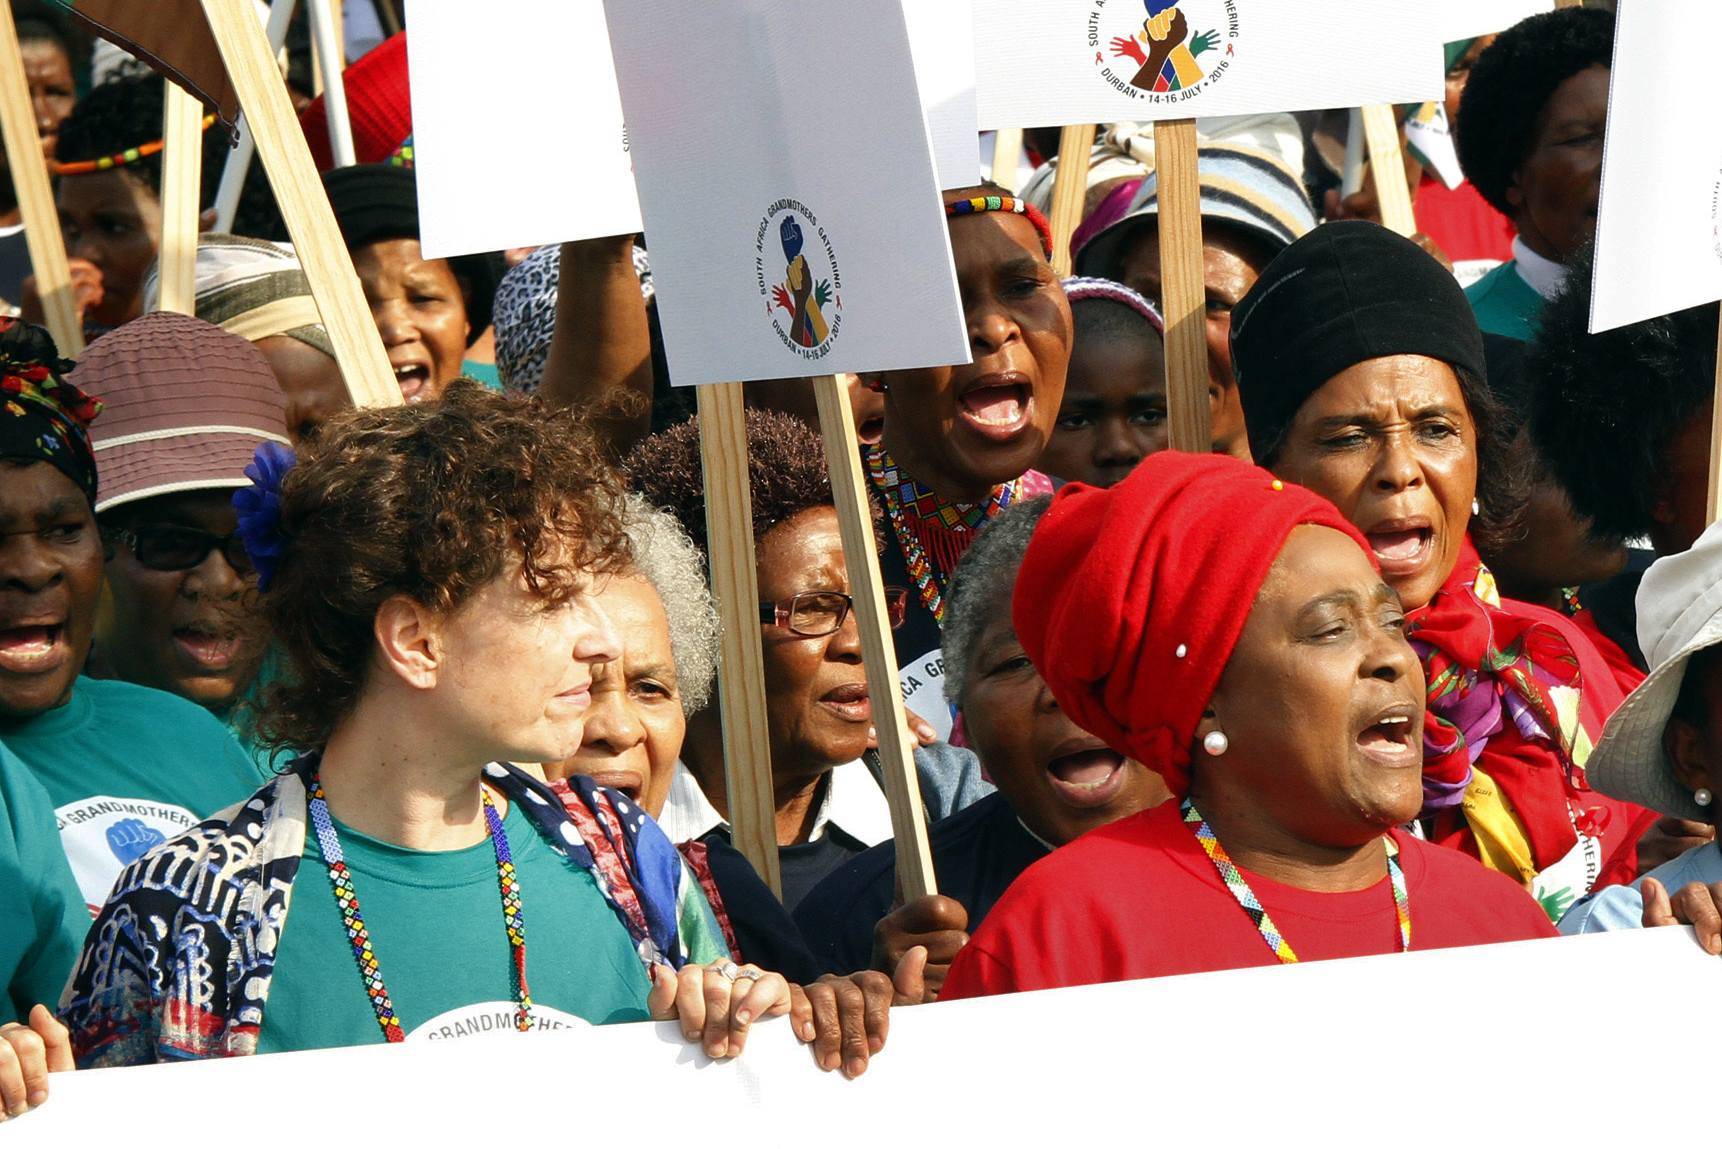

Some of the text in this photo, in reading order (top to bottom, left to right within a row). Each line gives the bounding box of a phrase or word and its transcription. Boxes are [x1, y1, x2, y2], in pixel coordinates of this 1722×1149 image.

[1088, 12, 1100, 46] SOUTH
[1101, 60, 1230, 103] DURBAN 14-16 JULY 2016
[756, 198, 842, 296] SOUTH AFRICA GRANDMOTHERS GATHERING
[772, 314, 842, 360] DURBAN 14-16 JULY 2016
